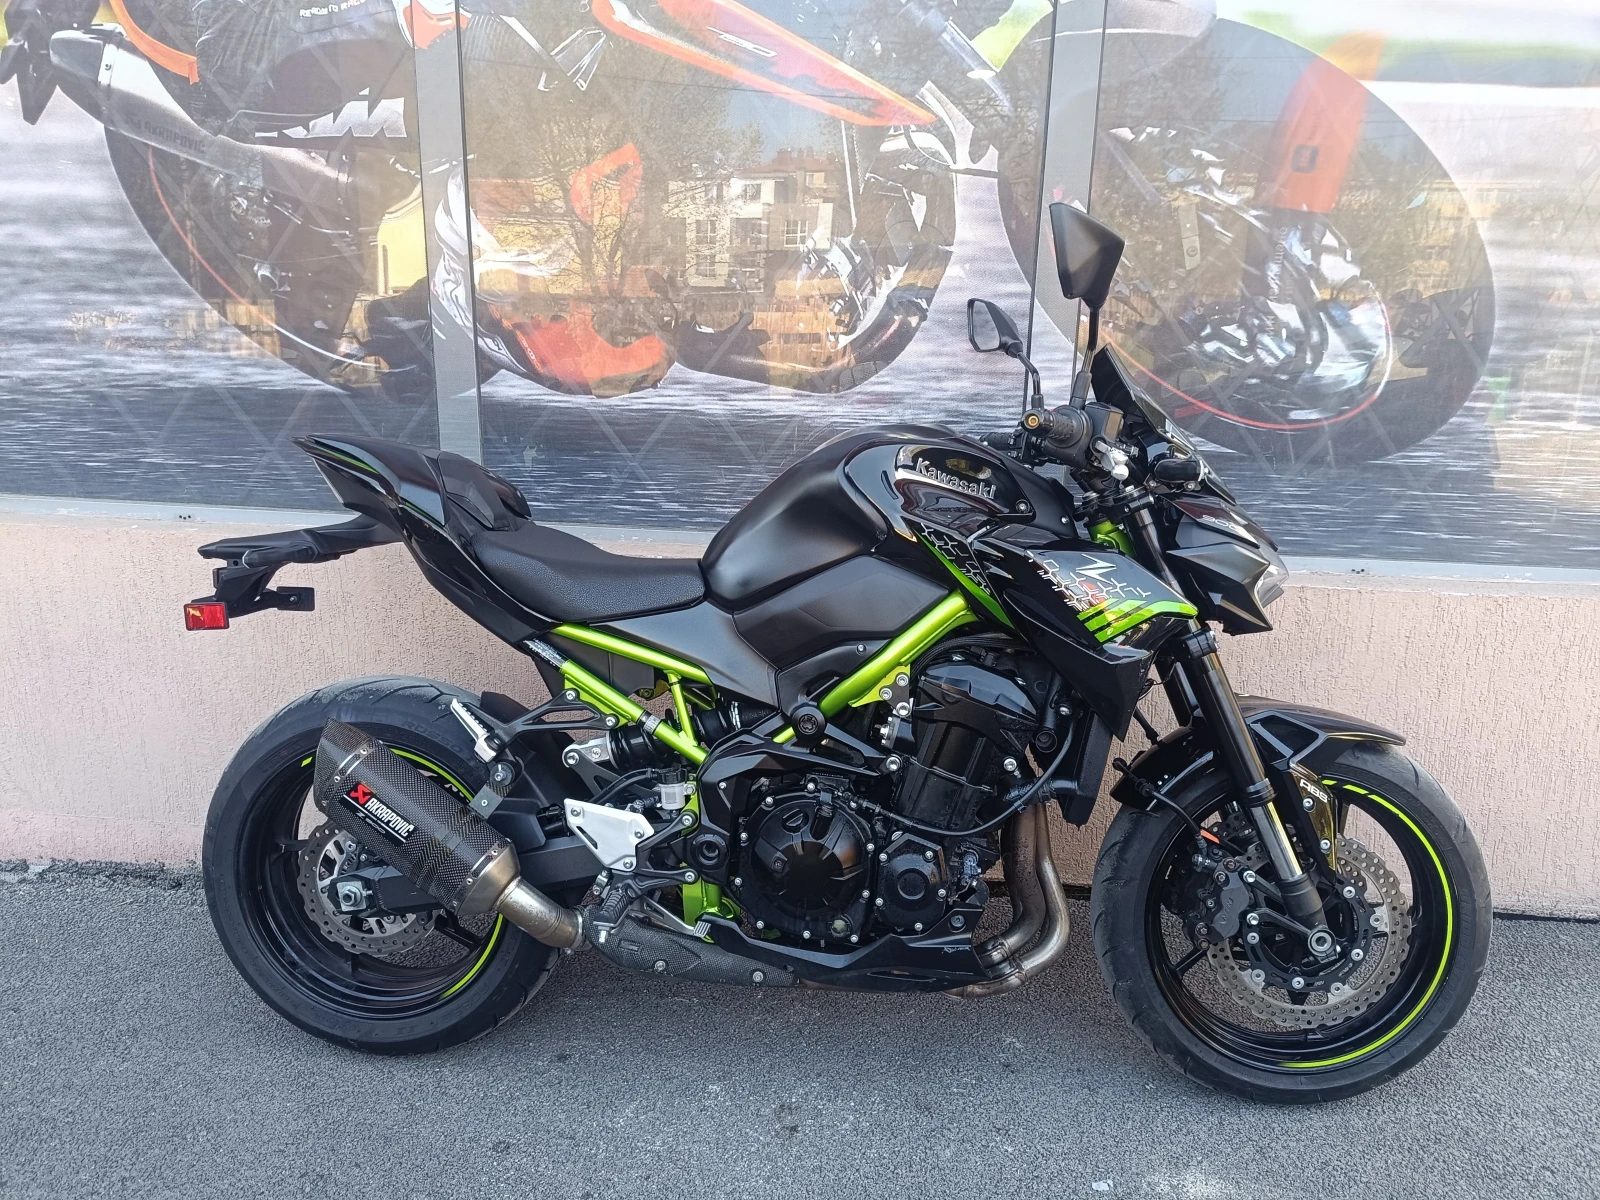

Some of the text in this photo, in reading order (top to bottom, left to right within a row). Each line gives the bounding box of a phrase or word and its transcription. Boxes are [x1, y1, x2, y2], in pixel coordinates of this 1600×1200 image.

[916, 458, 997, 499] Kawasaki
[401, 720, 464, 754] ROSSO
[1299, 778, 1328, 804] ABS
